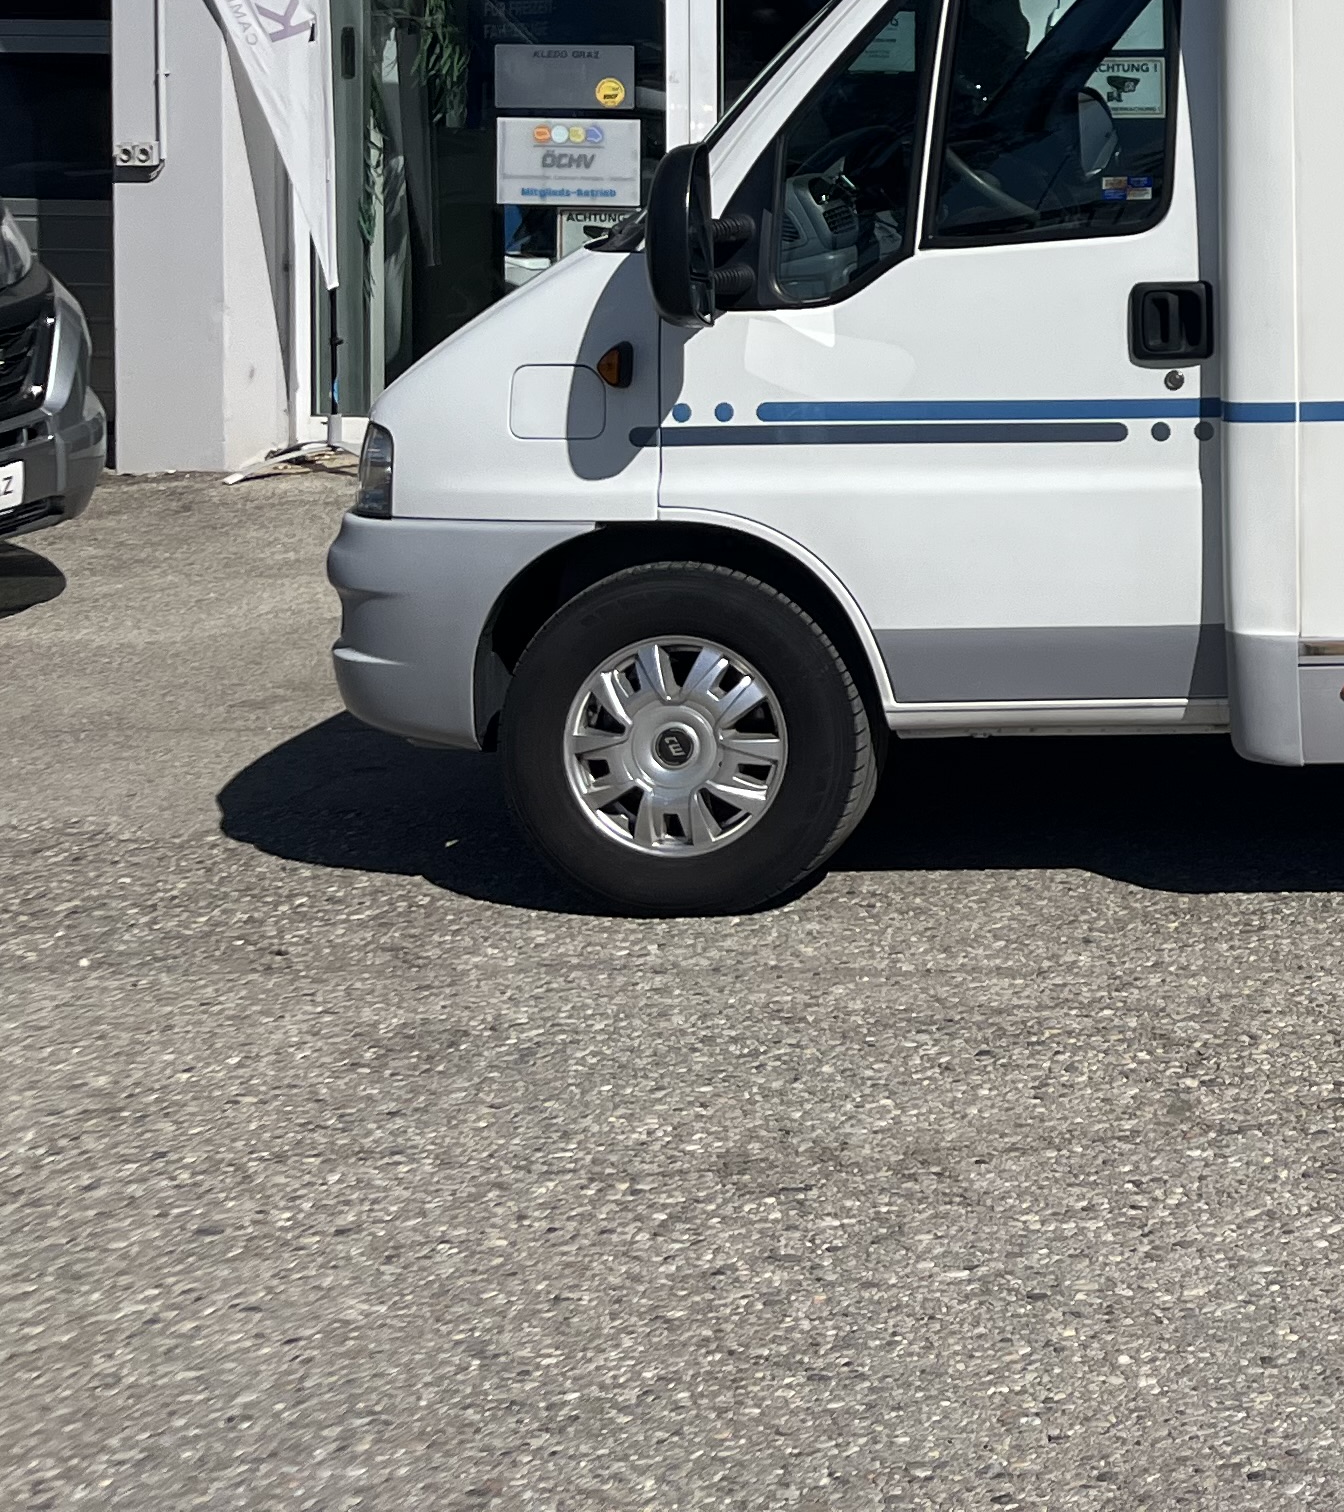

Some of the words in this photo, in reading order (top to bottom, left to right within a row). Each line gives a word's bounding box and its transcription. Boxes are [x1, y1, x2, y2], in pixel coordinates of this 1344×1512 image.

[532, 50, 568, 59] KLEDO
[571, 50, 601, 59] GRAZ
[1096, 63, 1149, 73] CHTUNG
